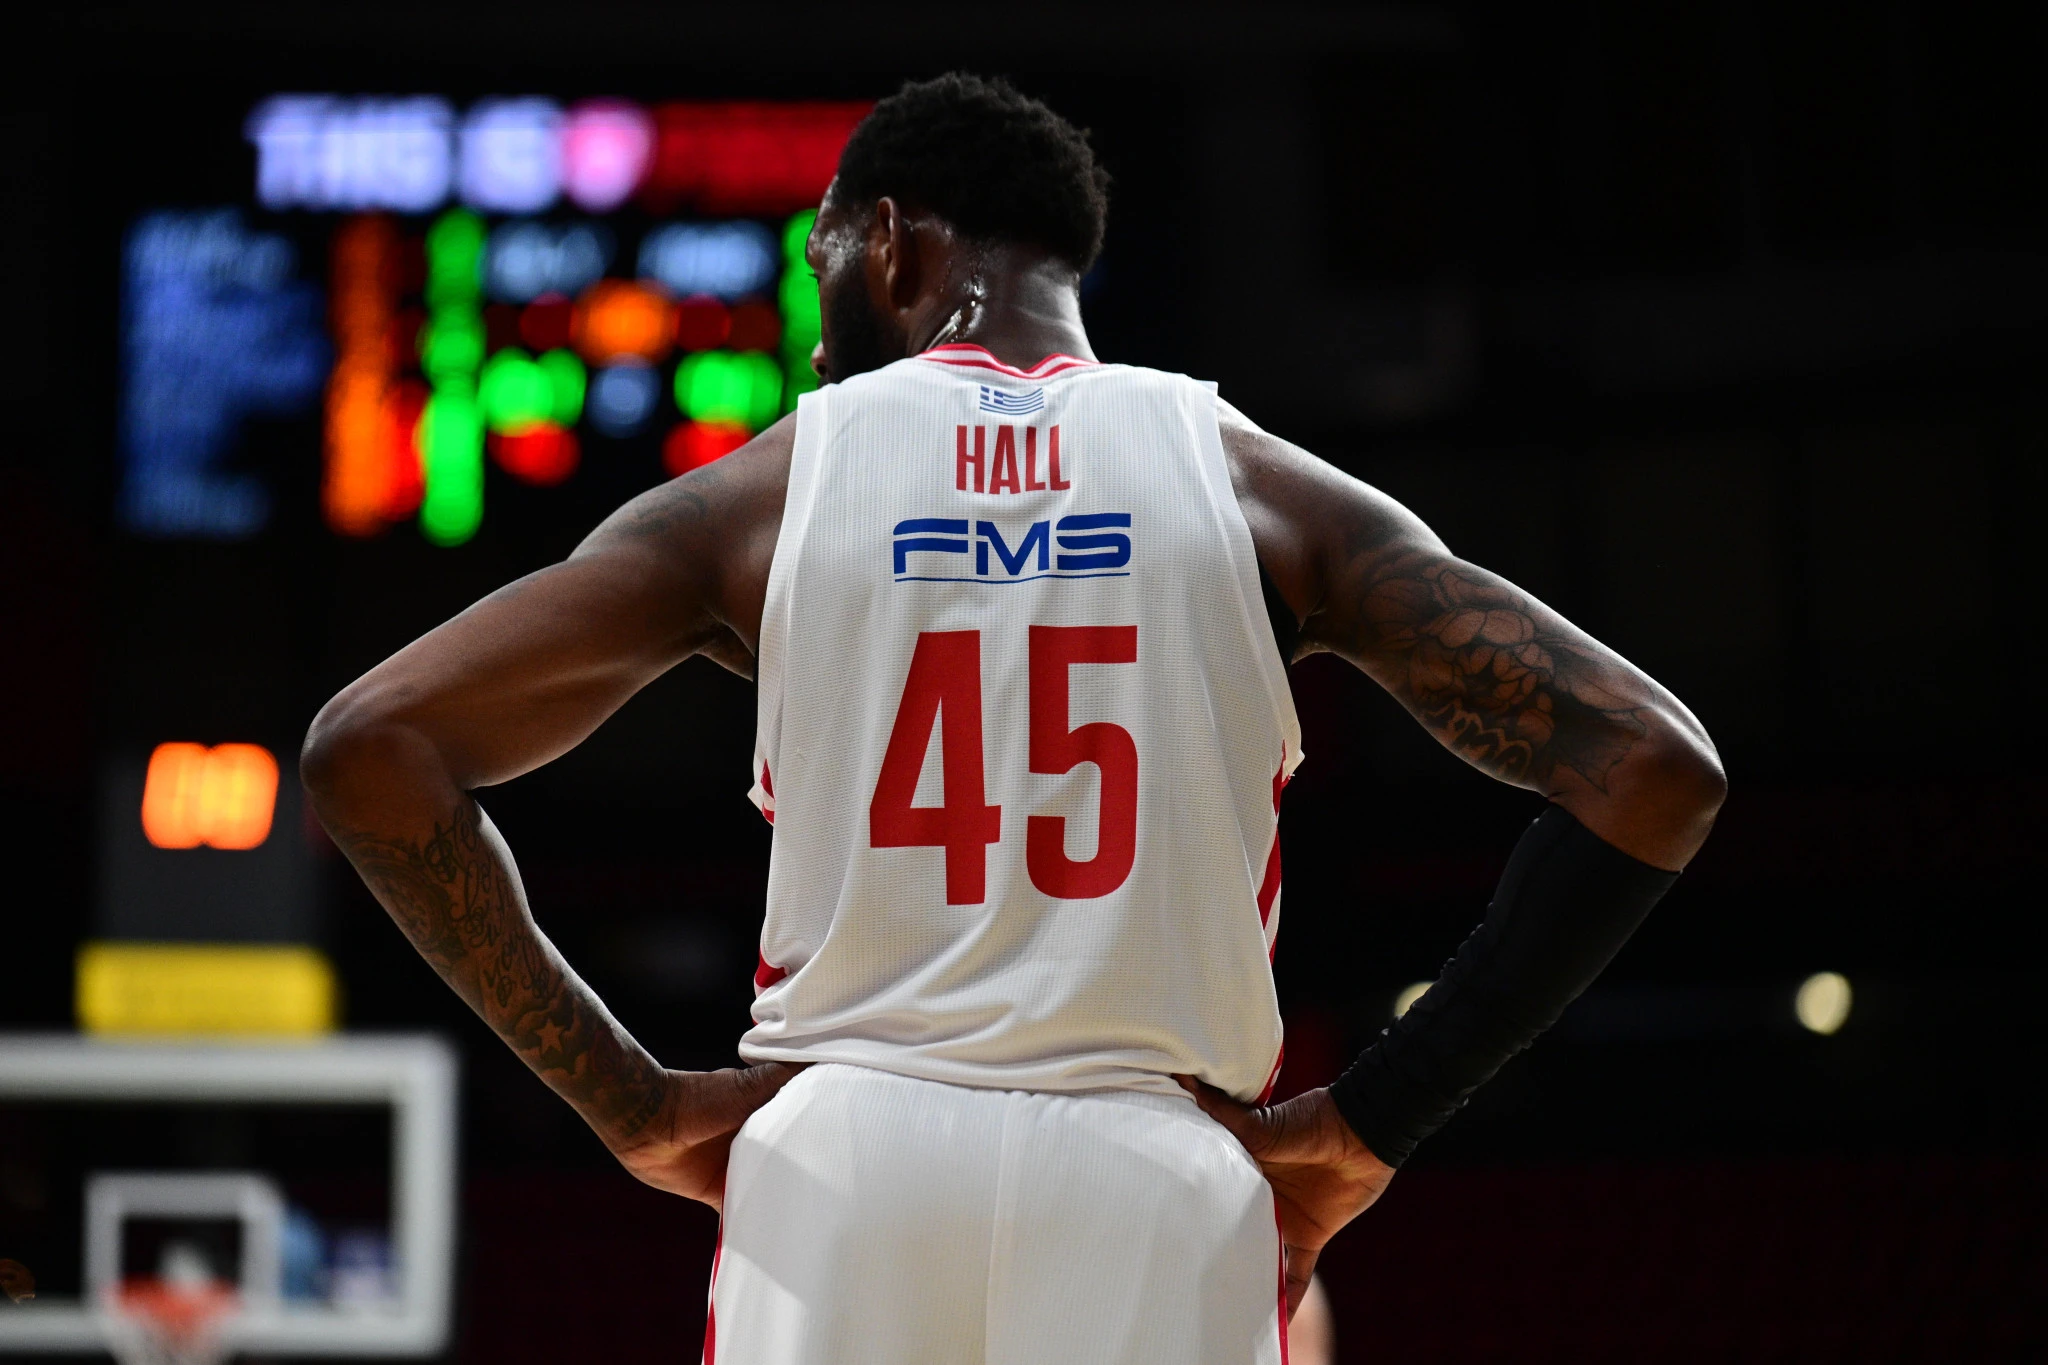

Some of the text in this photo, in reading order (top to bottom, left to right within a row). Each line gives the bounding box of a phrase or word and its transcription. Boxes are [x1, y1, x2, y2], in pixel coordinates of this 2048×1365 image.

[956, 424, 1071, 495] HALL
[893, 512, 1132, 576] FMS
[869, 624, 1139, 906] 45
